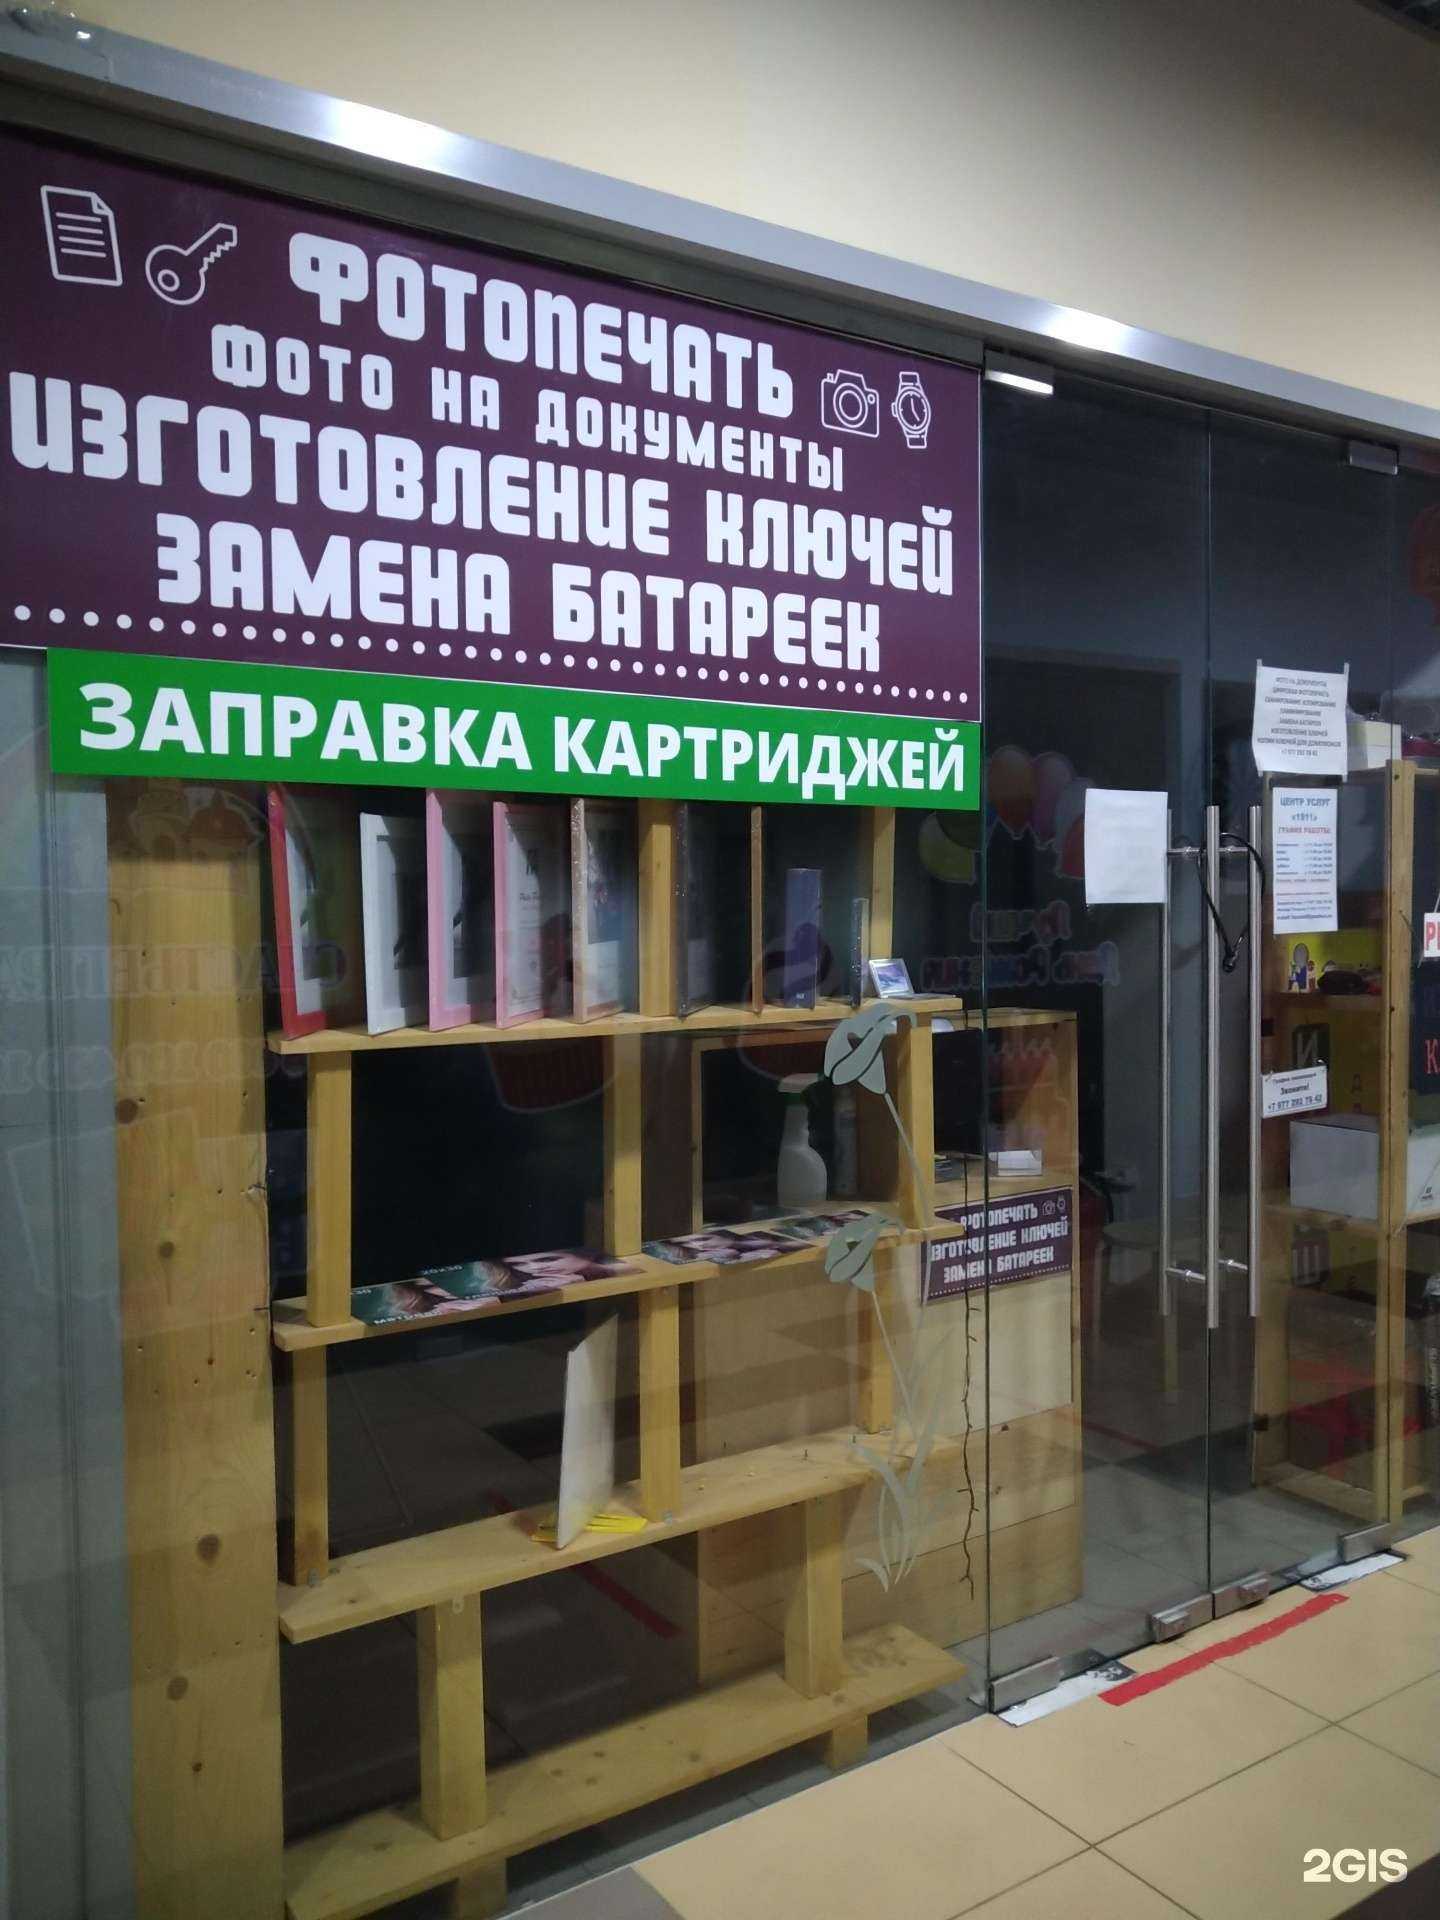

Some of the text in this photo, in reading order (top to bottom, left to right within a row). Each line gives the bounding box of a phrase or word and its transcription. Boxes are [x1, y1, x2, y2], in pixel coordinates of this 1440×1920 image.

[289, 232, 793, 418] ФОТОПЕЧАТЬ
[10, 371, 952, 596] ИЗГОТОВЛЕНИЕ КЛЮЧЕЙ
[211, 324, 843, 491] ФОТО НА ДОКУМЕНТЫ
[157, 512, 879, 672] ЗАМЕНА БАТАРЕЕК
[80, 682, 964, 800] ЗАПРАВКА КАРТРИДЖЕЙ
[997, 1246, 1054, 1272] БАТАРЕЕК
[1021, 1216, 1068, 1243] КЛЮЧЕЙ
